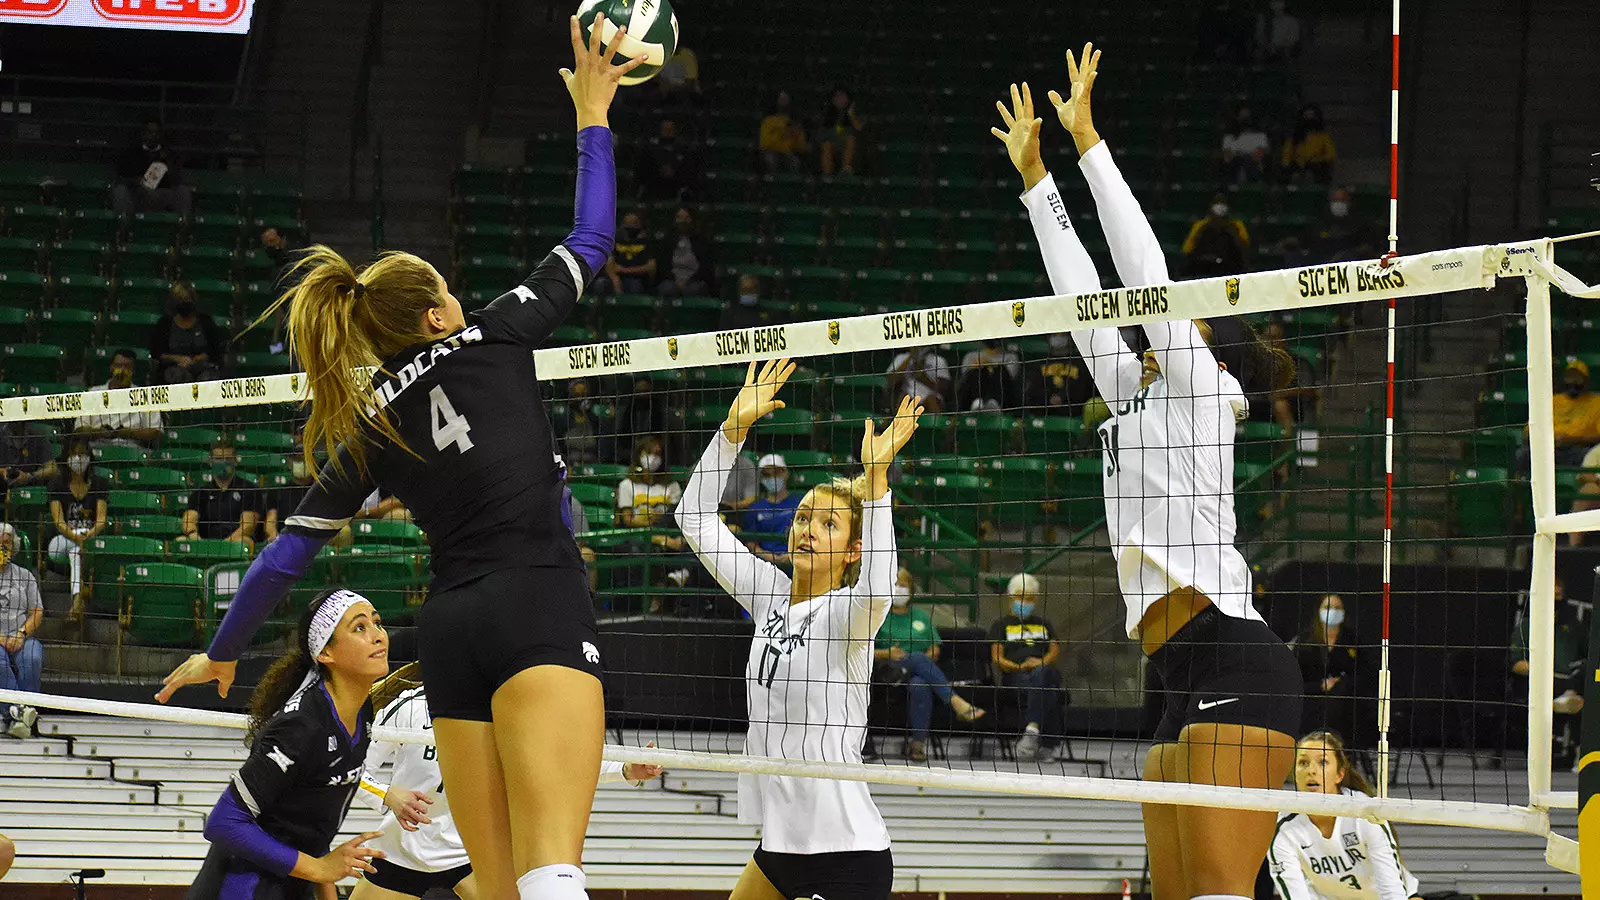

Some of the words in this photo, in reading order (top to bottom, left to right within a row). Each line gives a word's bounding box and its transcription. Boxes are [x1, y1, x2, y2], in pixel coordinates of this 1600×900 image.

[1126, 285, 1169, 317] BEARS
[927, 308, 963, 337] BEARS
[602, 342, 631, 367] BEARS
[754, 327, 787, 354] BEARS
[245, 377, 266, 397] BEARS
[428, 384, 475, 455] 4
